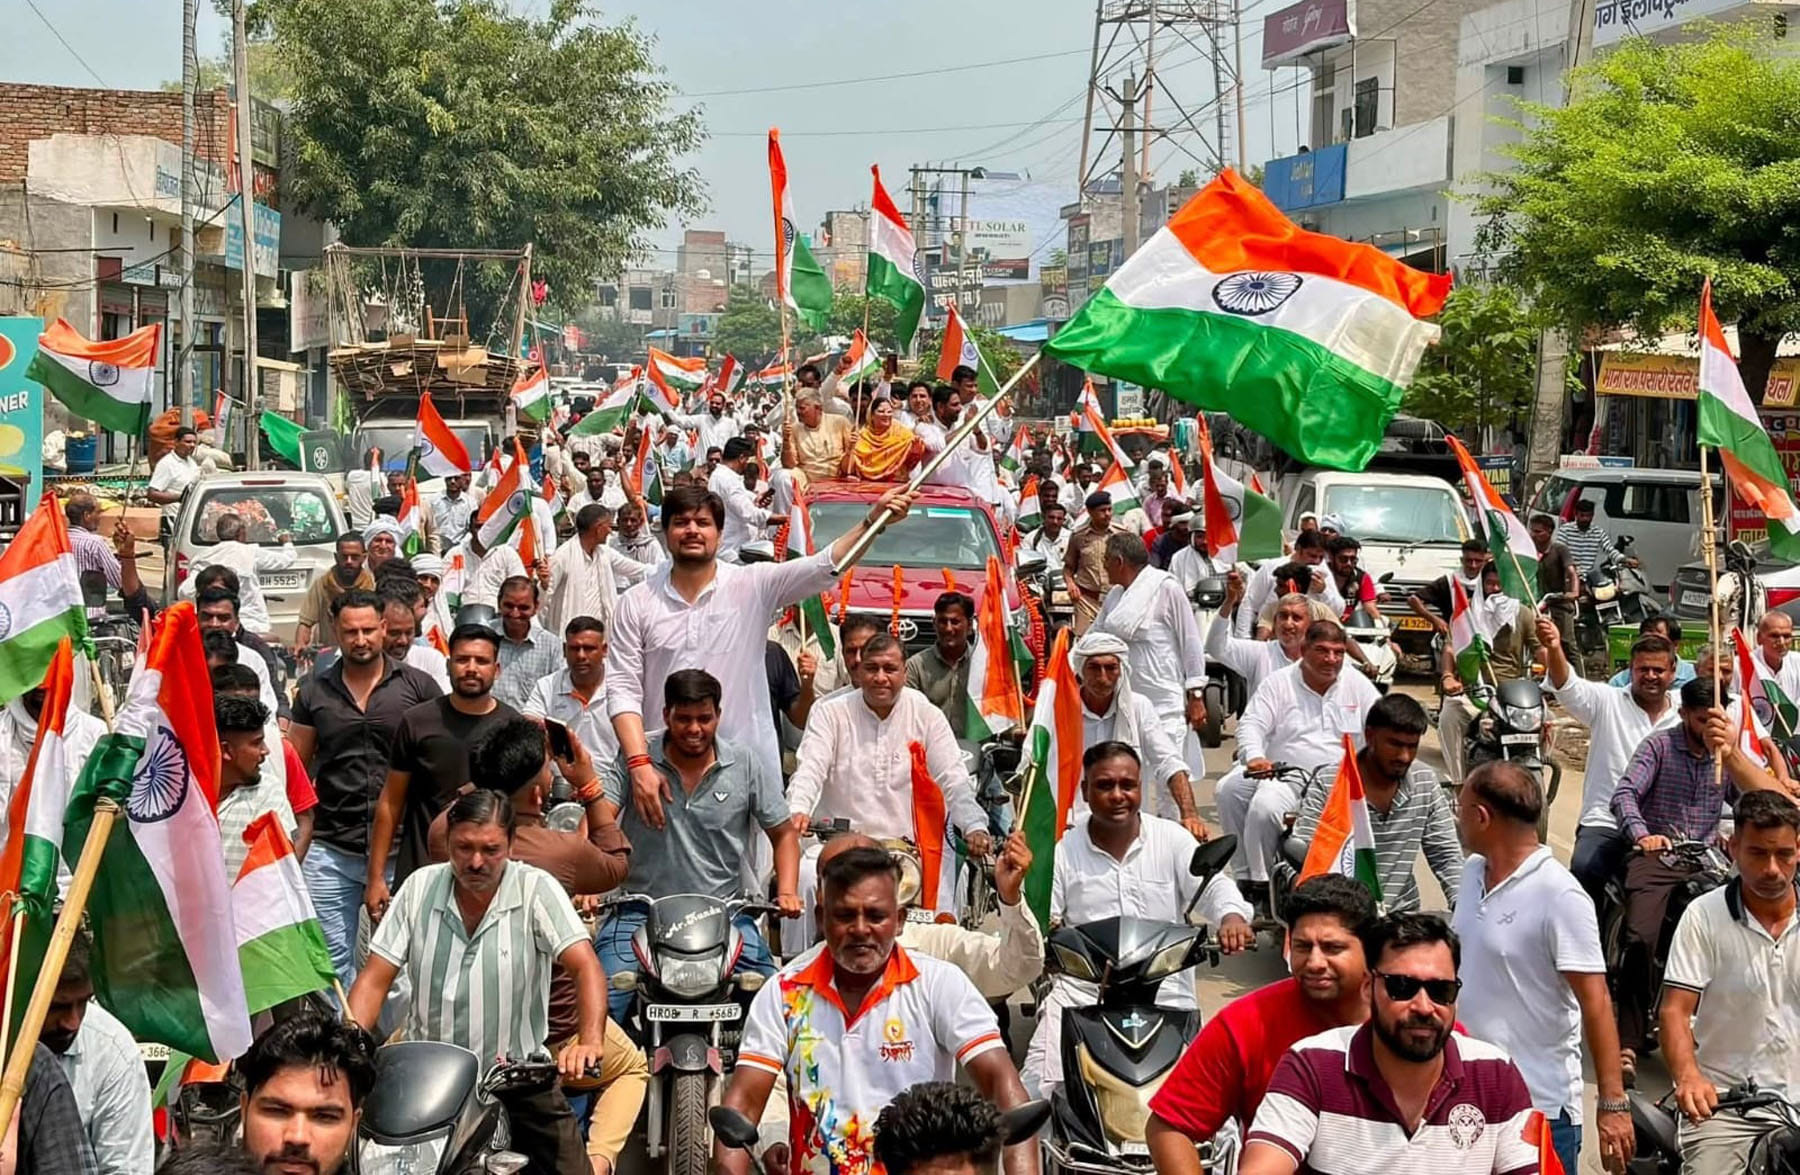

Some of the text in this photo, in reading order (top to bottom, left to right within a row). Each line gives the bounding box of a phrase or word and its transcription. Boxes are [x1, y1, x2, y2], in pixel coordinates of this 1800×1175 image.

[985, 221, 1026, 233] SOLAR
[1481, 468, 1511, 484] YAM
[692, 1008, 699, 1019] R
[716, 1006, 739, 1019] 5687
